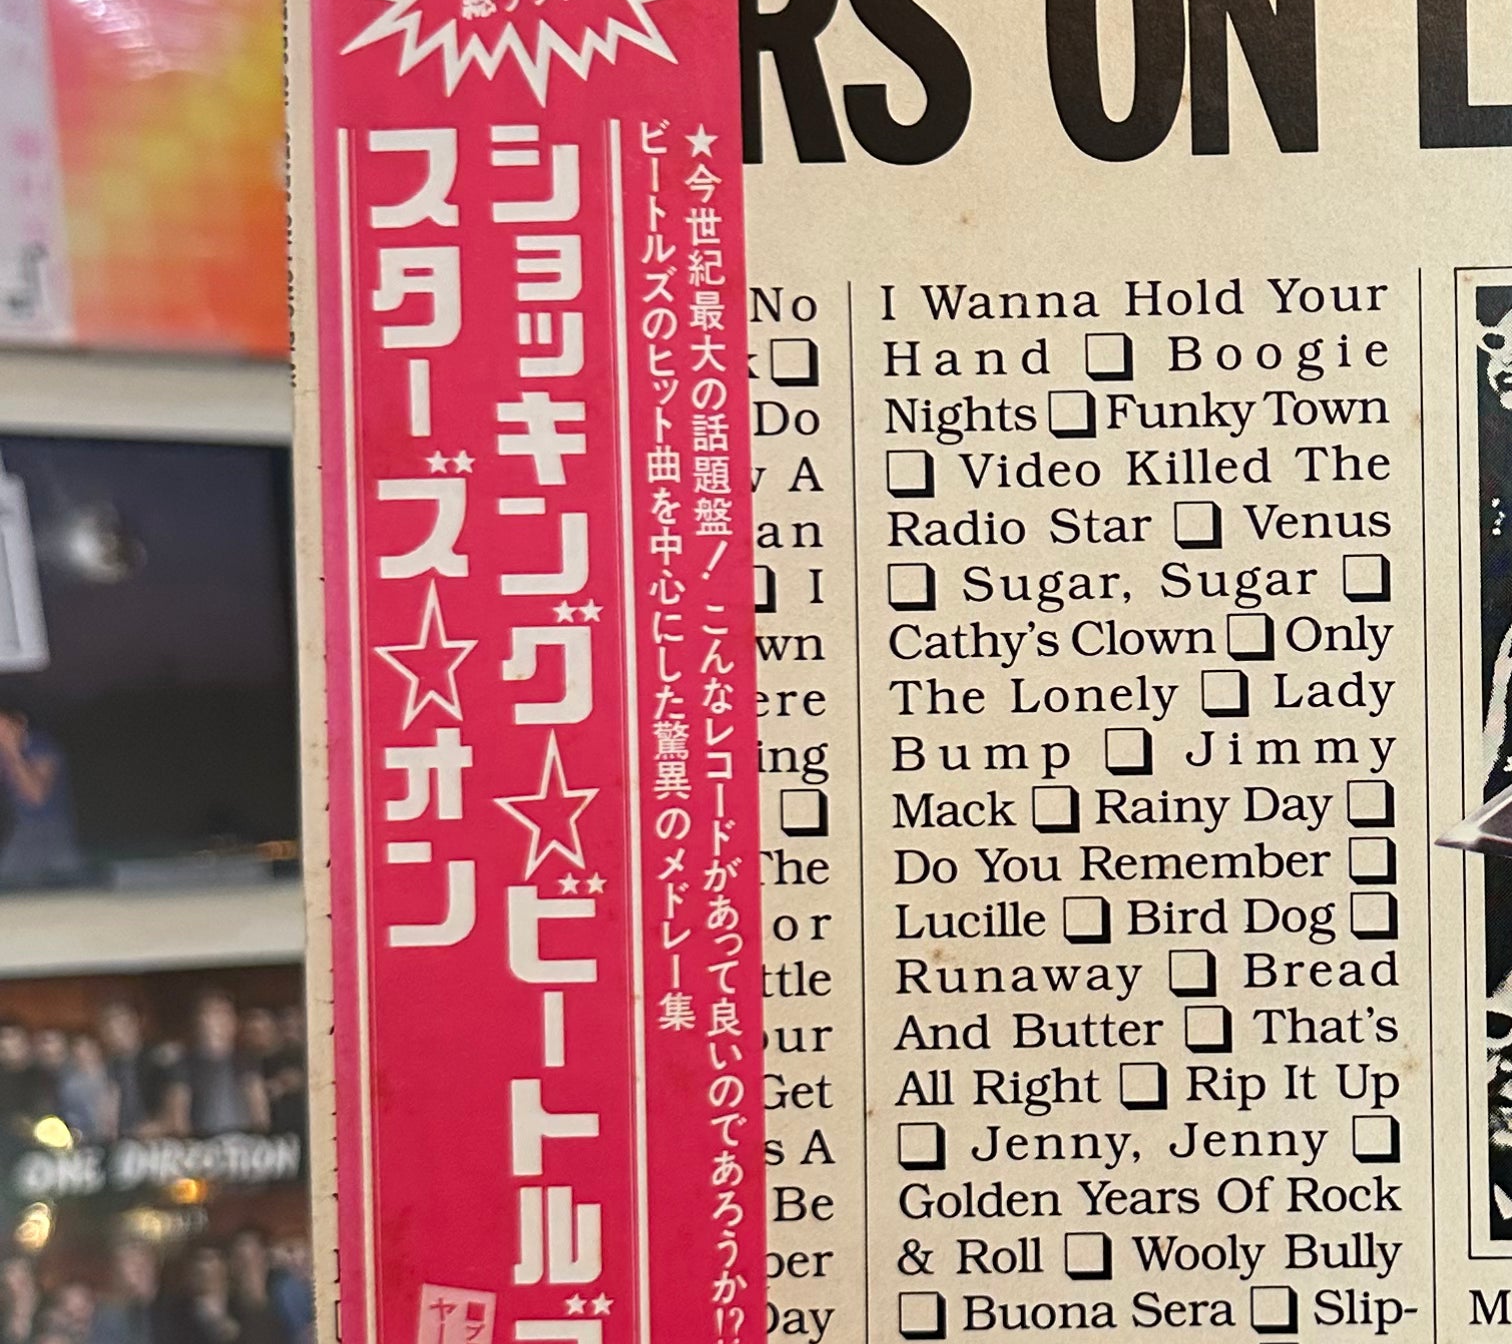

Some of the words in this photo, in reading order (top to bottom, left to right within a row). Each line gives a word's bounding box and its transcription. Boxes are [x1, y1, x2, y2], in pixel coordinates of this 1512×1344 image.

[750, 285, 818, 323] No
[880, 285, 896, 321] I
[919, 284, 1100, 321] Wanna
[1124, 277, 1245, 317] Hold
[1266, 277, 1389, 314] Your
[883, 337, 1051, 377] Hand
[1167, 333, 1388, 382] Boogie
[755, 399, 821, 437] Do
[788, 456, 824, 493] A
[957, 451, 1101, 489] Video
[1125, 446, 1272, 486] Killed
[1294, 444, 1390, 482] The
[641, 119, 696, 1031] ビートルズのヒット曲を中心にした驚異のメドレー集
[808, 567, 824, 604] I
[962, 565, 1131, 614] Sugar,
[1160, 561, 1318, 610] Sugar
[888, 620, 1060, 669] Cathy's
[1071, 619, 1217, 657] Clown
[1285, 614, 1395, 662] Only
[891, 736, 1070, 780] Bump
[1185, 730, 1397, 774] Jimmy
[893, 849, 958, 885] Do
[974, 847, 1063, 883] You
[1079, 841, 1332, 881] Remember
[895, 958, 1143, 1002] Runaway
[1243, 949, 1400, 989] Bread
[893, 1013, 991, 1051] And
[1012, 1013, 1164, 1049] Butter
[1252, 1006, 1399, 1045] That's
[894, 1069, 955, 1107] All
[972, 1066, 1102, 1117] Right
[1185, 1065, 1266, 1112] Rip
[1283, 1064, 1318, 1100] It
[1335, 1063, 1400, 1110] Up
[799, 1128, 836, 1165] A
[971, 1125, 1141, 1170] Jenny,
[1169, 1122, 1329, 1167] Jenny
[773, 1185, 835, 1222] Be
[898, 1181, 1063, 1220] Golden
[1076, 1180, 1200, 1216] Years
[1217, 1175, 1275, 1214] Of
[1286, 1174, 1403, 1213] Rock
